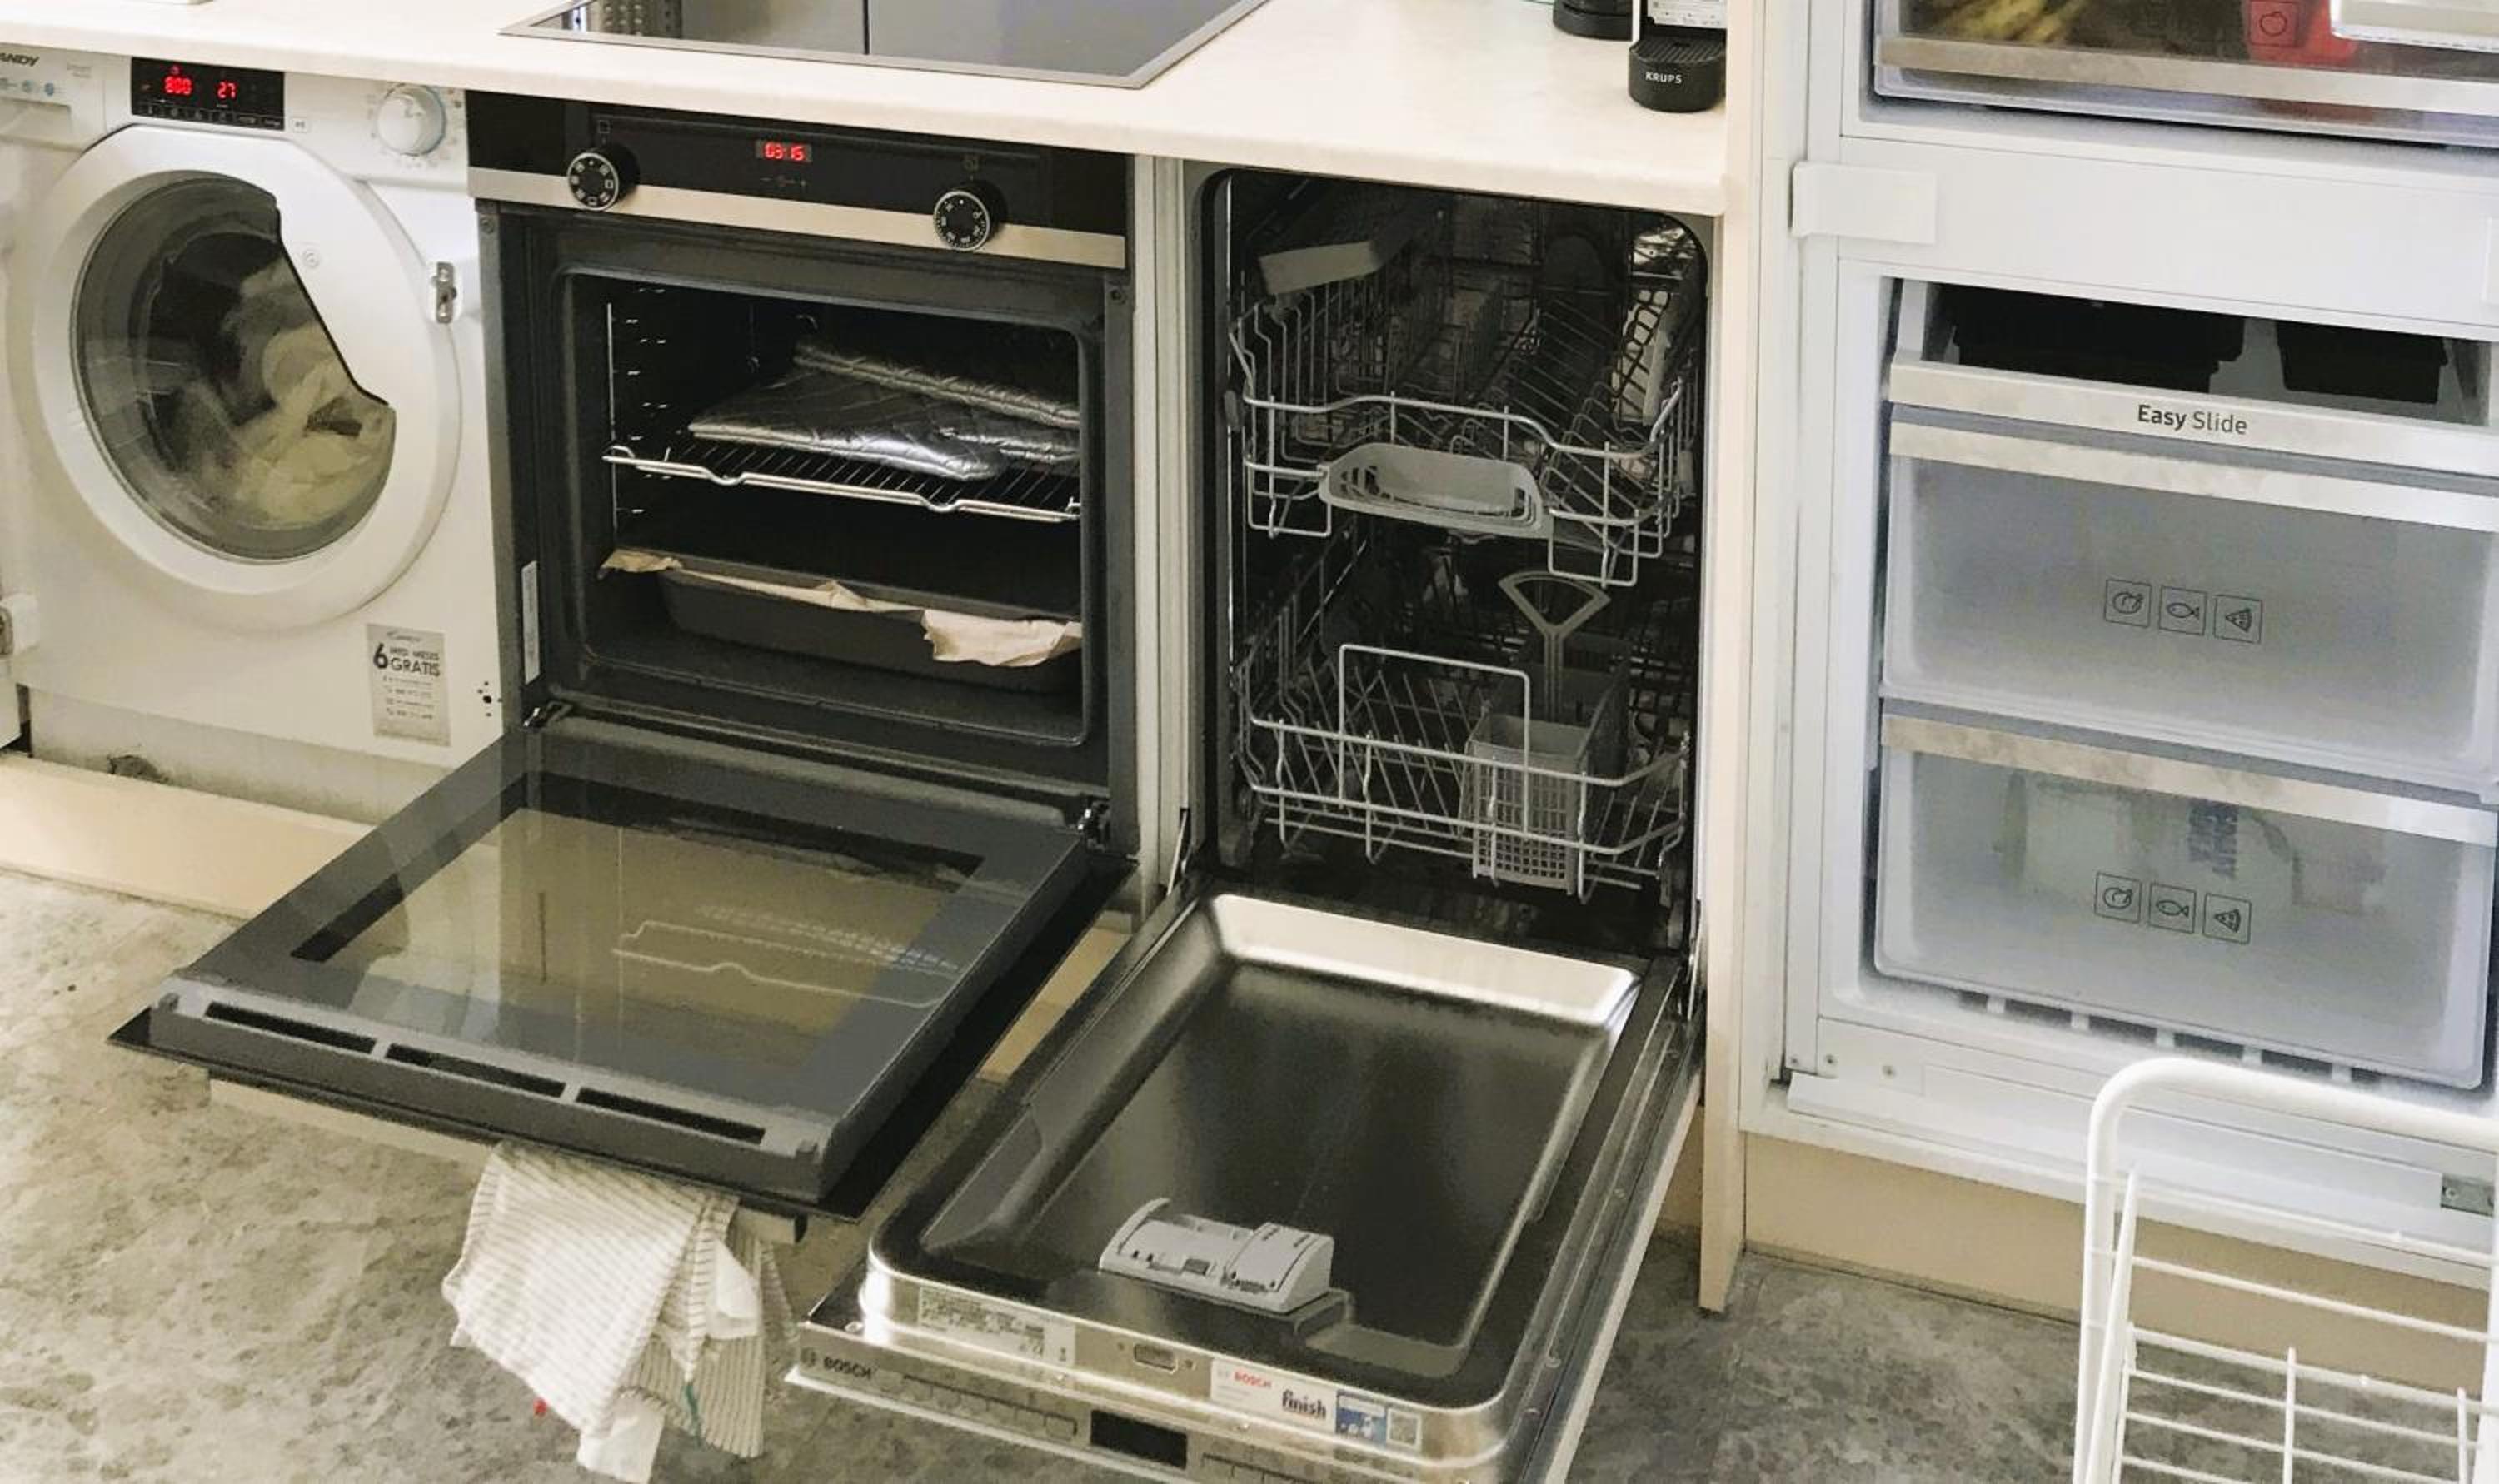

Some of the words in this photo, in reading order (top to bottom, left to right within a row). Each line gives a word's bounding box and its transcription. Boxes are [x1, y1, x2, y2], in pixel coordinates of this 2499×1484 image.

[1644, 72, 1683, 83] KRUPS
[217, 82, 237, 99] 27
[2137, 404, 2187, 431] Easy
[2192, 410, 2248, 435] Slide
[373, 642, 388, 670] 6
[390, 656, 441, 677] GRATIS
[824, 1356, 872, 1381] BOSCH
[1233, 1371, 1273, 1389] BOSCH
[1281, 1388, 1327, 1420] finish
